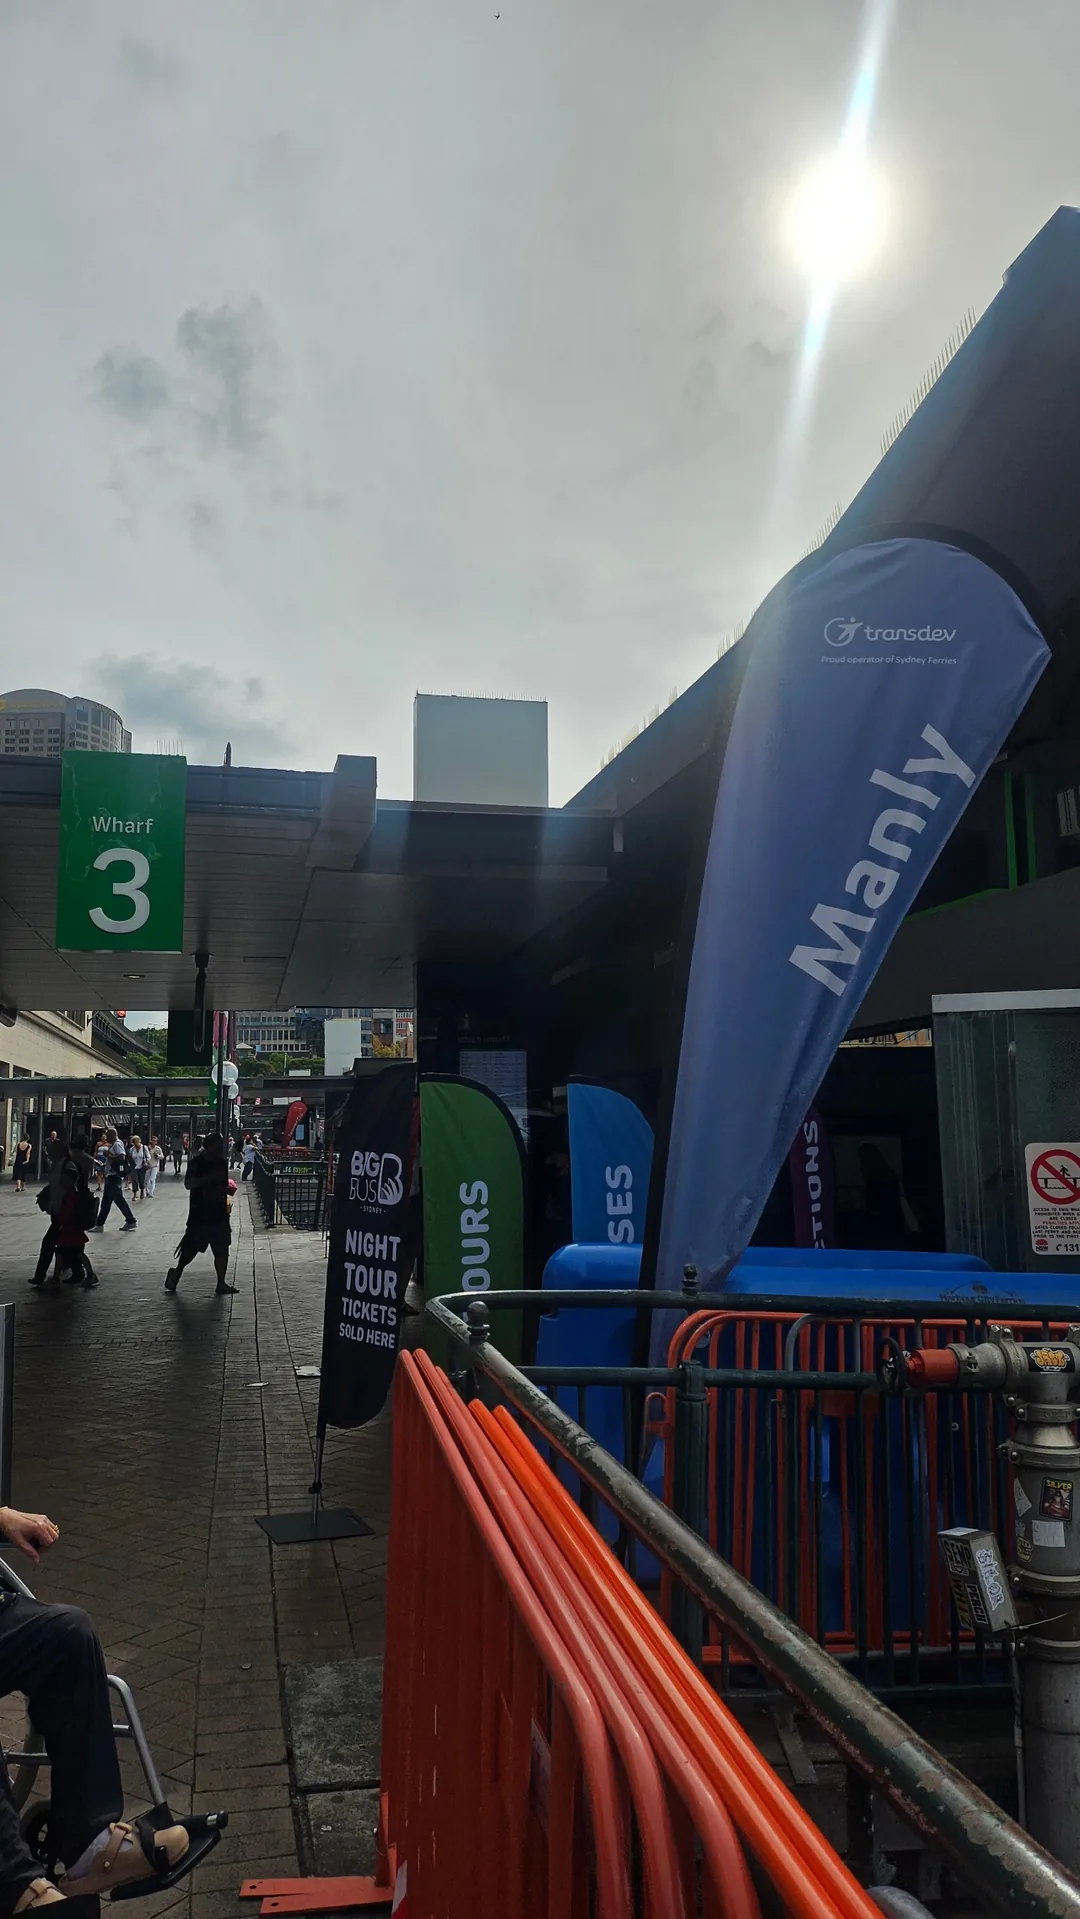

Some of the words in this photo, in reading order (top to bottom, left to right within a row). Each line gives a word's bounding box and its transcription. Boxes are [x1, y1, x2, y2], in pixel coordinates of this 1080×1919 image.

[864, 625, 956, 642] transdev
[848, 656, 884, 665] operator
[885, 655, 894, 664] of
[895, 655, 926, 665] Sydney
[928, 657, 957, 665] Ferries
[92, 816, 153, 834] Wharf
[788, 723, 976, 997] Manly
[88, 848, 151, 934] 3
[350, 1150, 380, 1178] BIG
[348, 1177, 377, 1203] BUS
[344, 1228, 401, 1262] NIGHT
[459, 1180, 490, 1322] OURS
[344, 1261, 397, 1300] TOUR
[341, 1296, 397, 1327] TICKETS
[338, 1322, 364, 1342] SOLD
[365, 1328, 396, 1349] HERE
